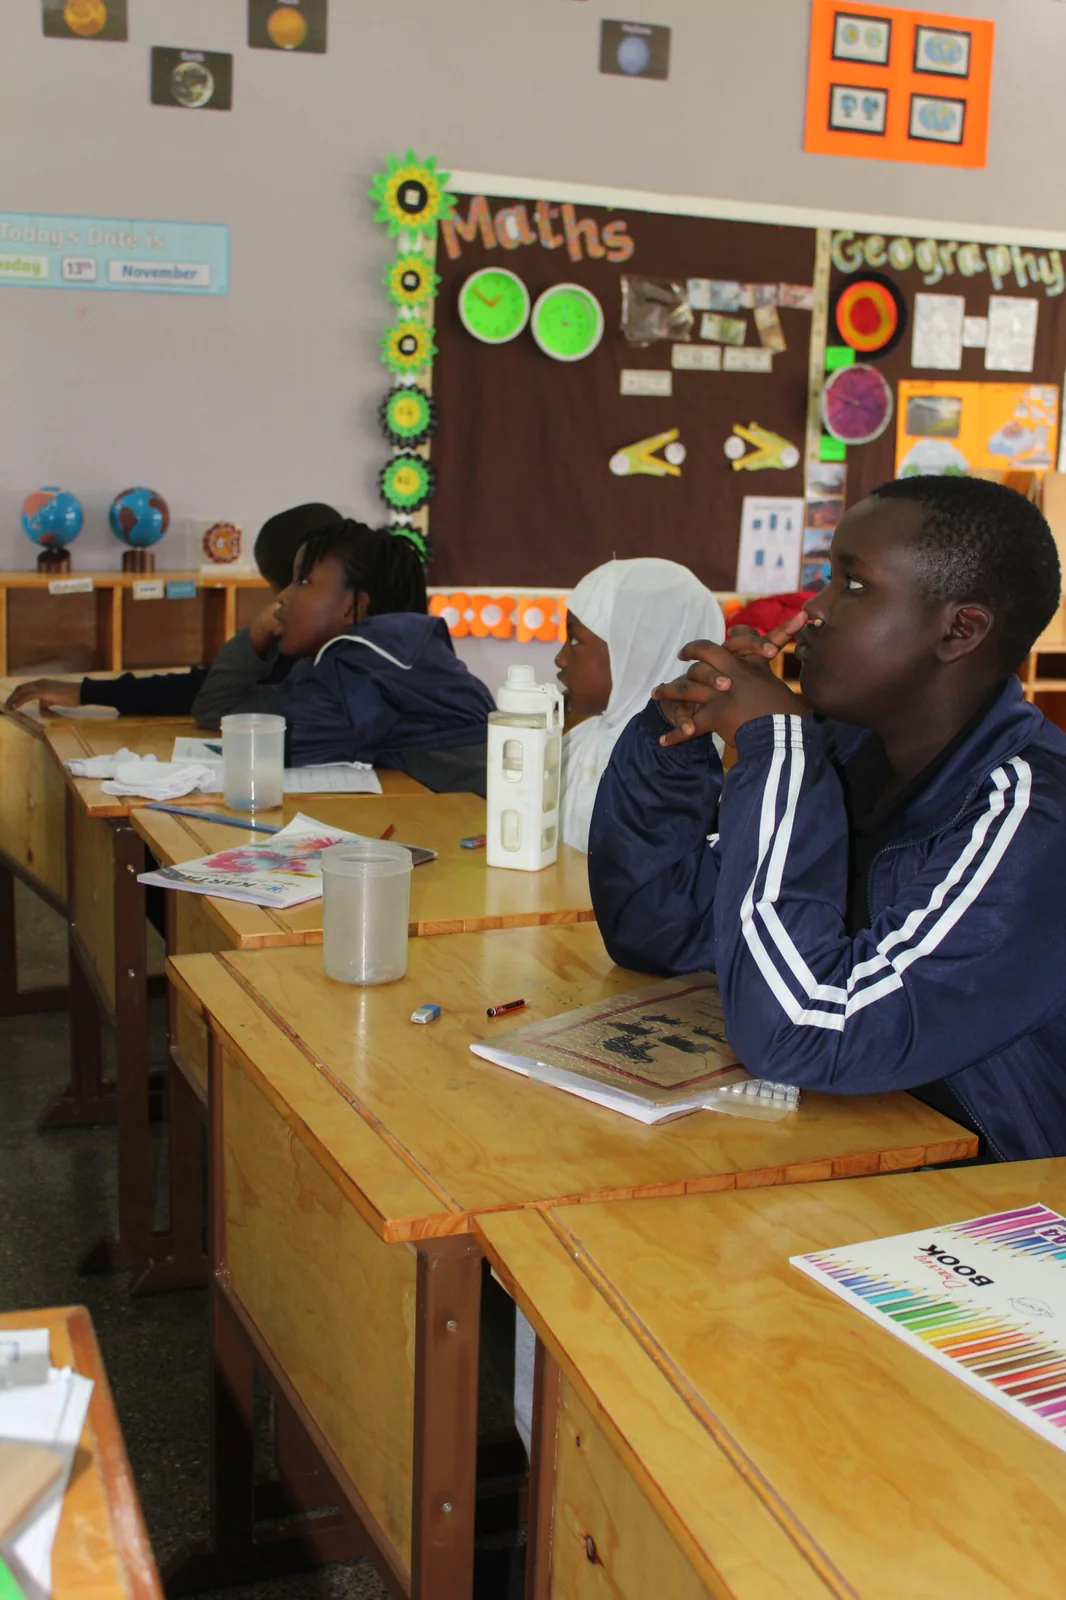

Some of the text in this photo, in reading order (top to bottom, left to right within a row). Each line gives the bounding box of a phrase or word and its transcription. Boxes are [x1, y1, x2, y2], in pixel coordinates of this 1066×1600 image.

[0, 219, 166, 250] Today's Date is
[440, 194, 635, 262] Maths
[121, 265, 198, 280] November
[830, 229, 1065, 298] Geography
[917, 1243, 995, 1287] BOOK
